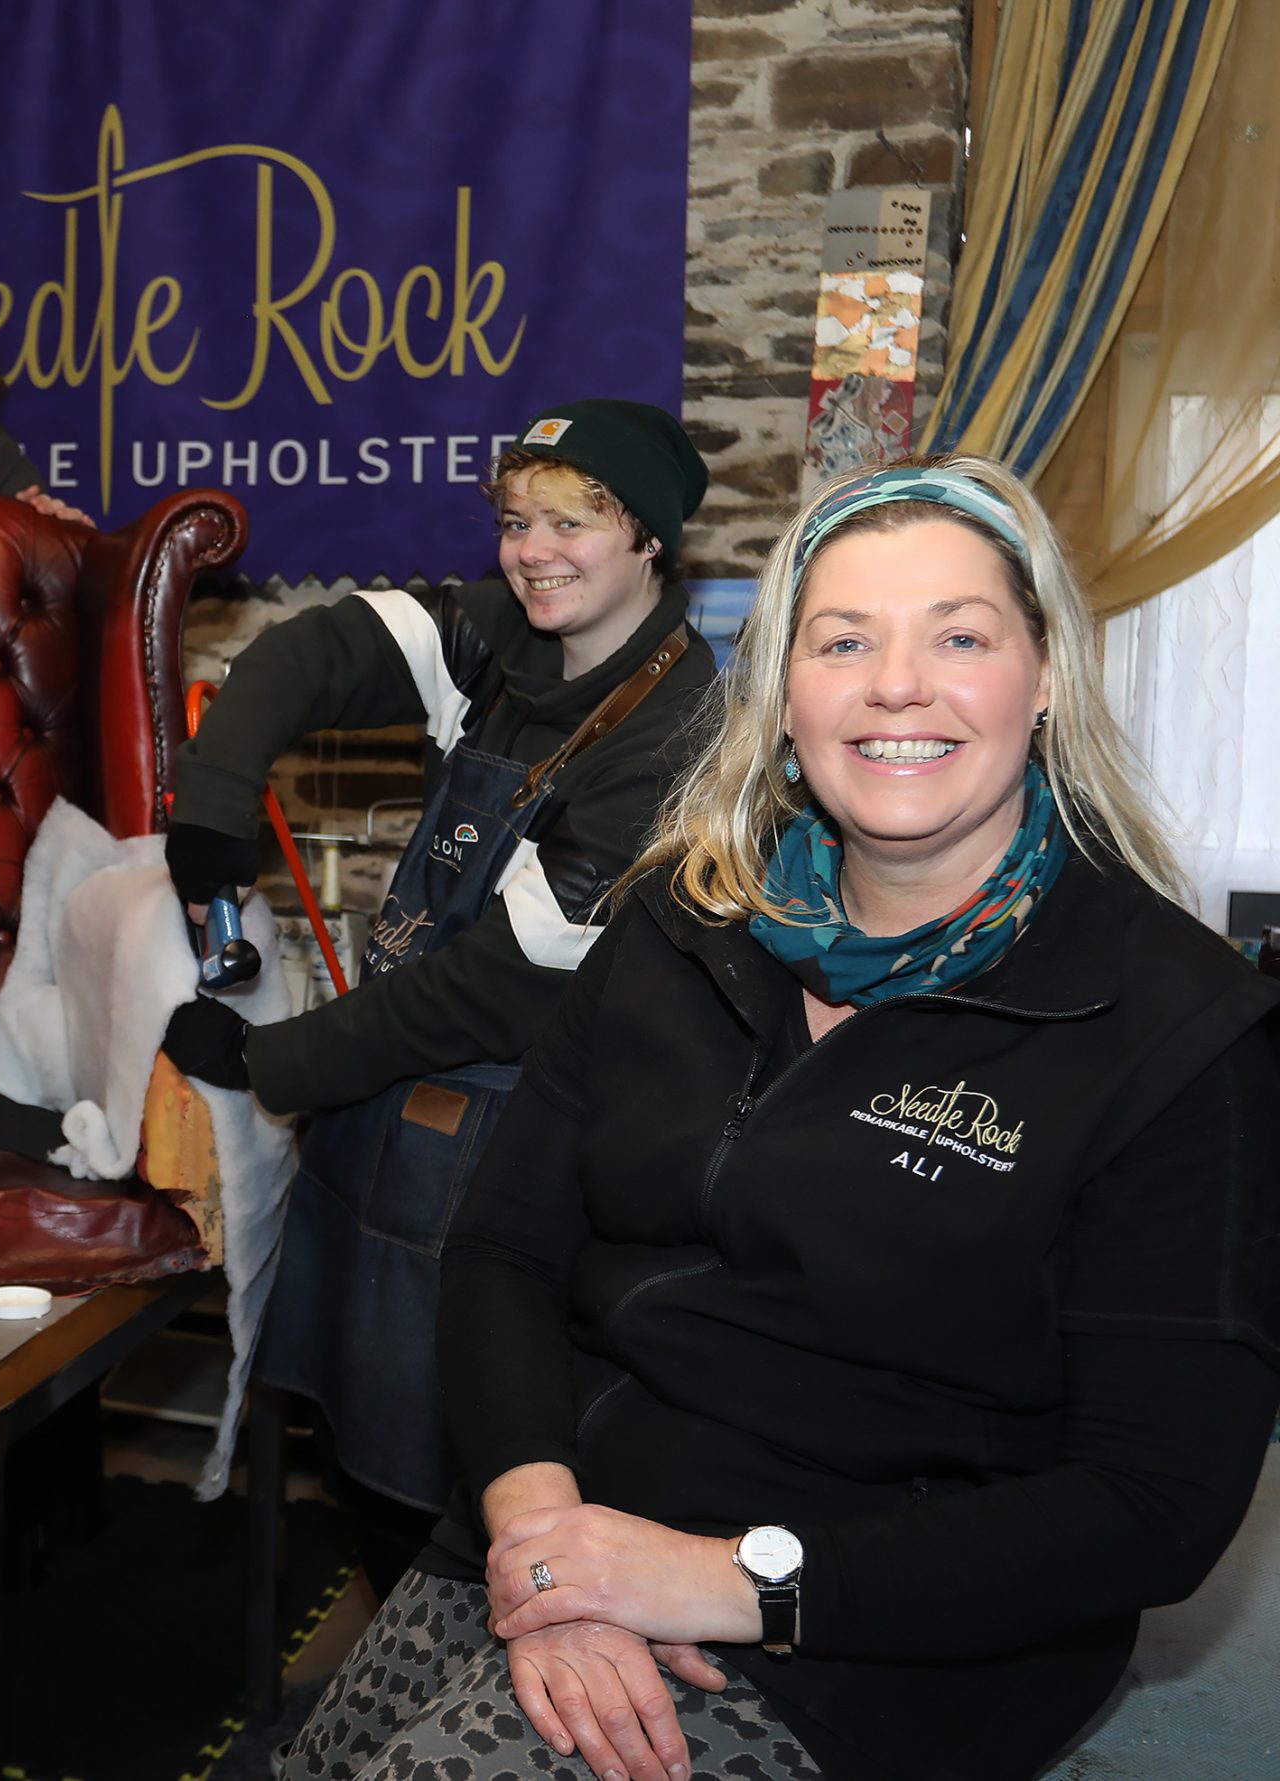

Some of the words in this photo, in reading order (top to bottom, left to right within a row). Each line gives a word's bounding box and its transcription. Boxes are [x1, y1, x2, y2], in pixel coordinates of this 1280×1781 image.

[200, 145, 526, 411] Rock
[849, 1109, 929, 1140] REMARKABLE
[934, 1134, 1016, 1173] UPHOLSTERY
[870, 1080, 966, 1146] Needle
[954, 1091, 1024, 1154] Rock
[890, 1151, 944, 1182] ALI
